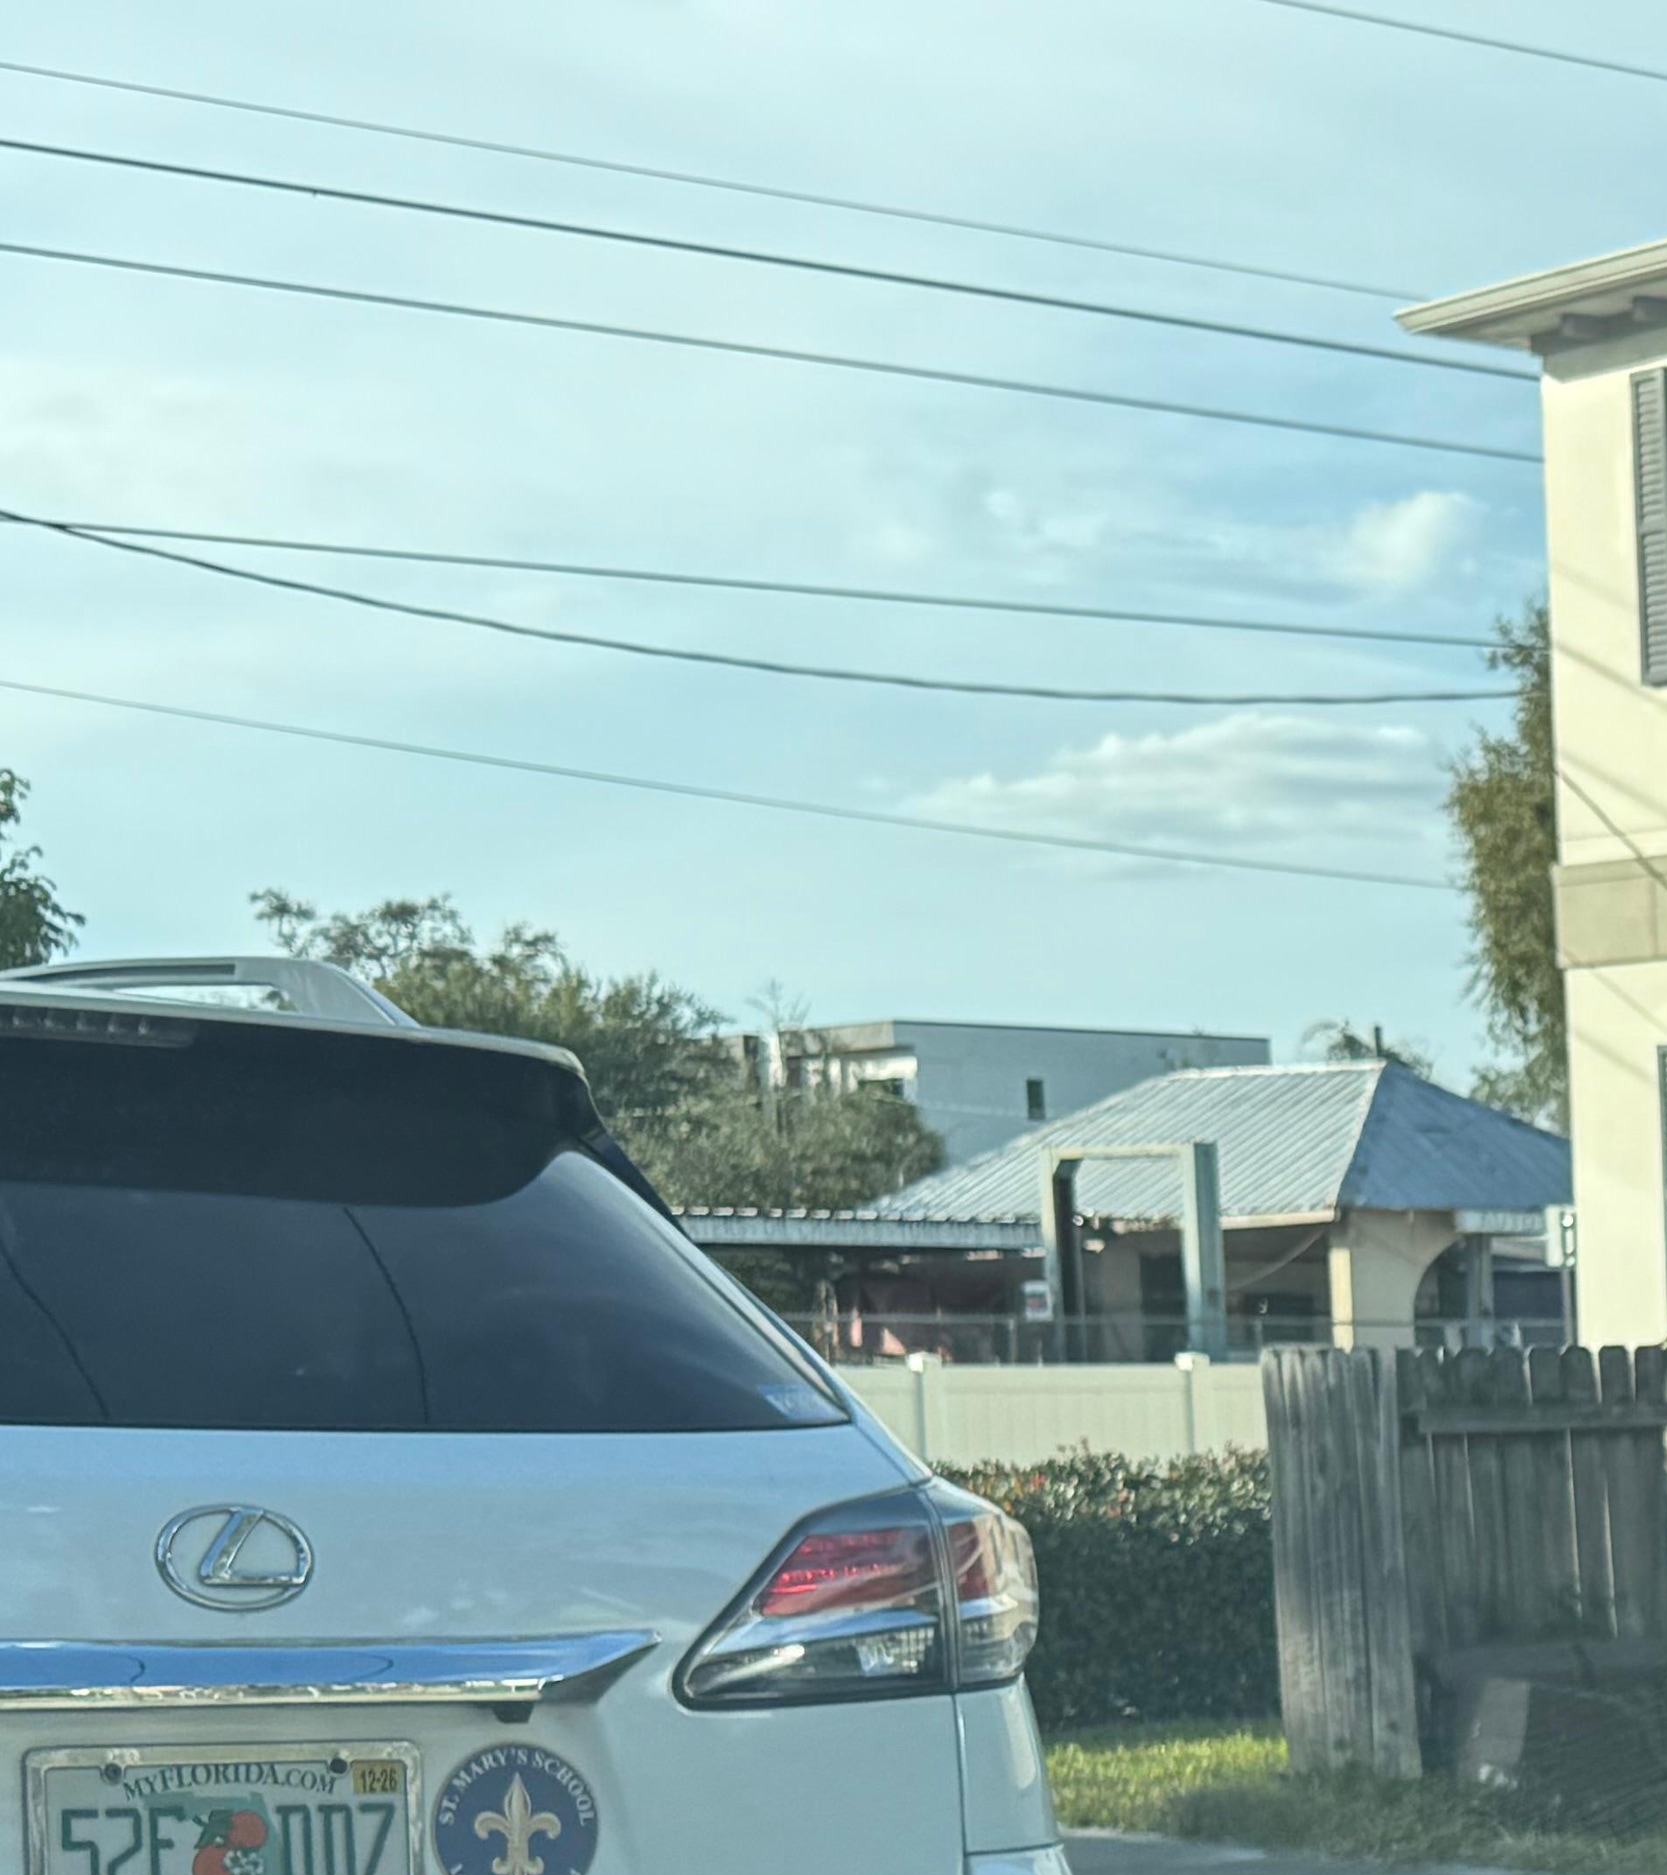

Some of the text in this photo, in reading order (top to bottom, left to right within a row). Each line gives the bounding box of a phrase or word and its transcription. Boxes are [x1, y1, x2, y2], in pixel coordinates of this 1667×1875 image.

[122, 1762, 337, 1801] MYFLORIDA.COM
[452, 1748, 529, 1794] MARY'S
[532, 1751, 596, 1827] SCHOOL
